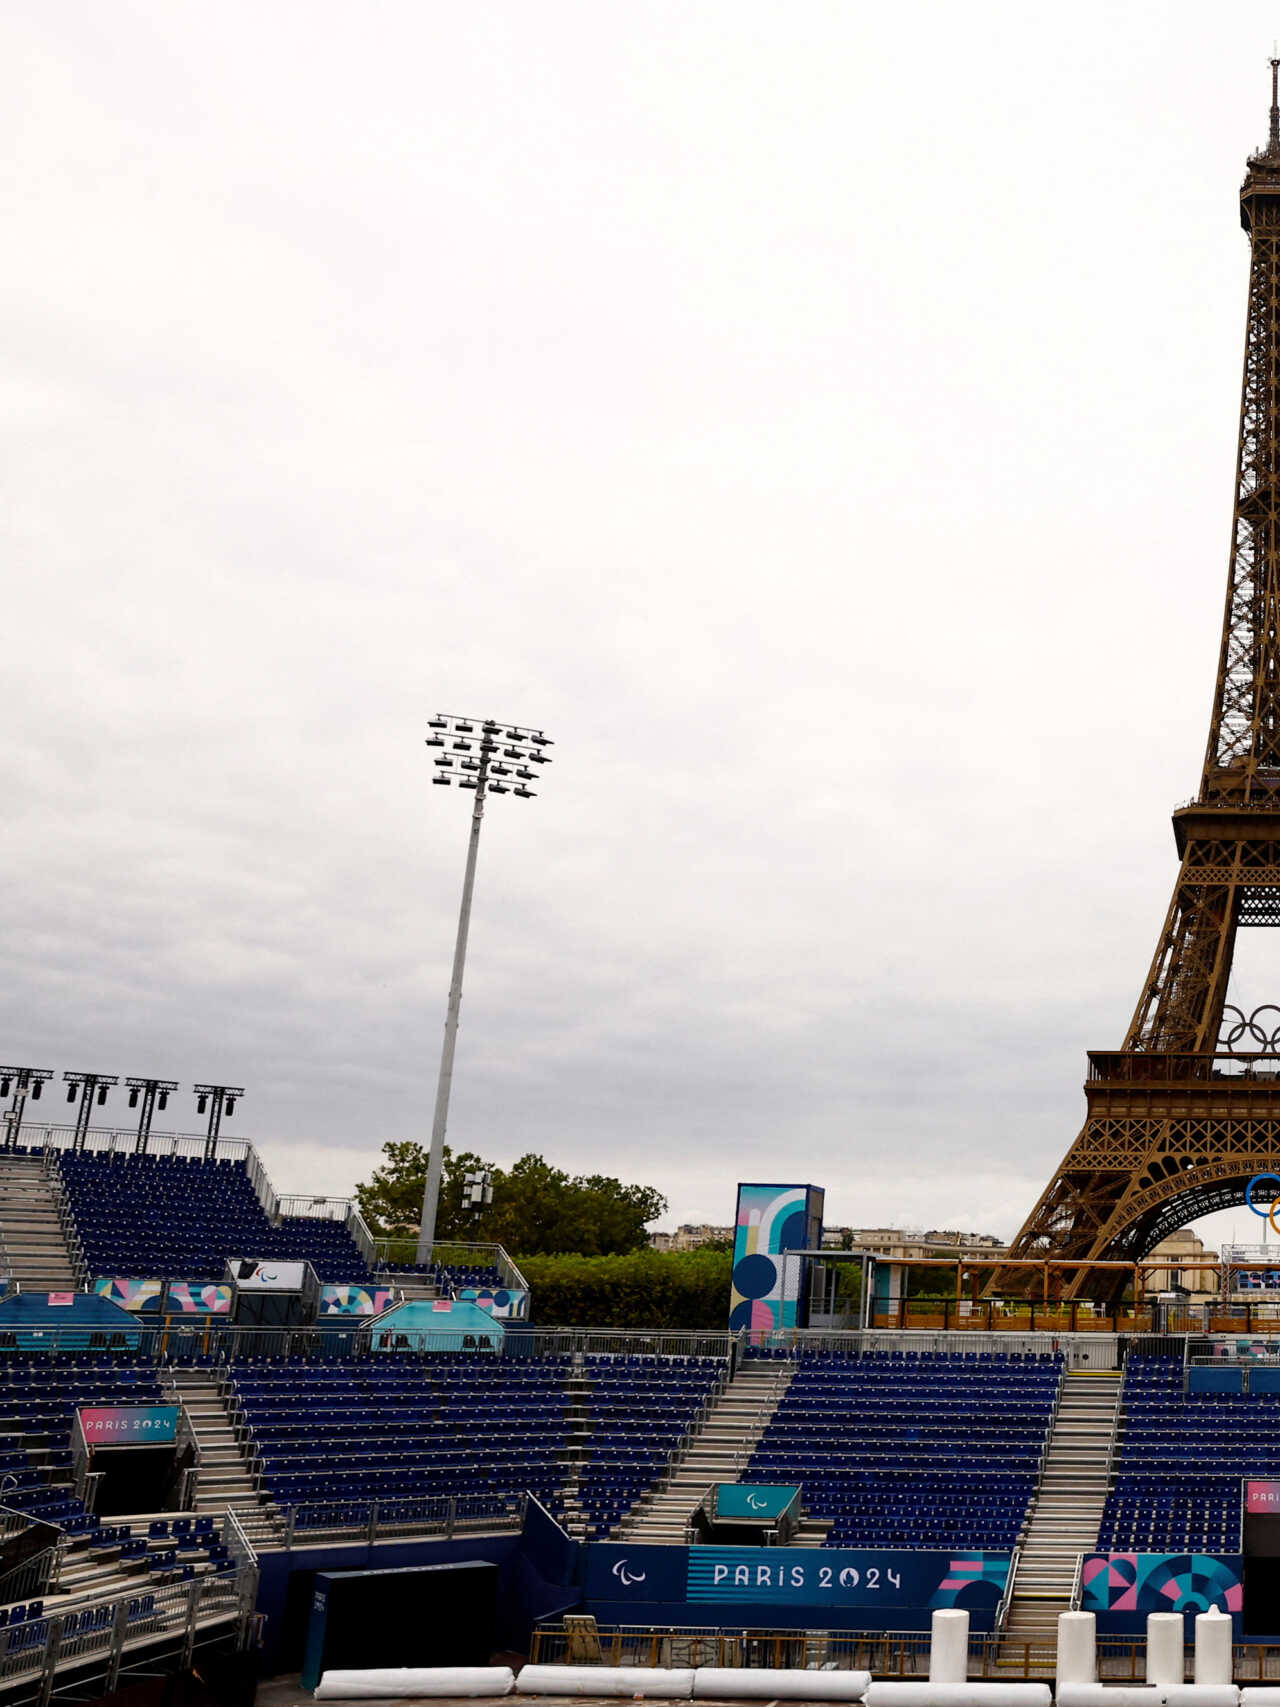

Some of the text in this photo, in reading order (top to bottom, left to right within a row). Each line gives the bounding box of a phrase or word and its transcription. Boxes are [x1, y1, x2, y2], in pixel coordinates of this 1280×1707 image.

[86, 1419, 170, 1430] PARIS 2024
[818, 1567, 901, 1589] 2024
